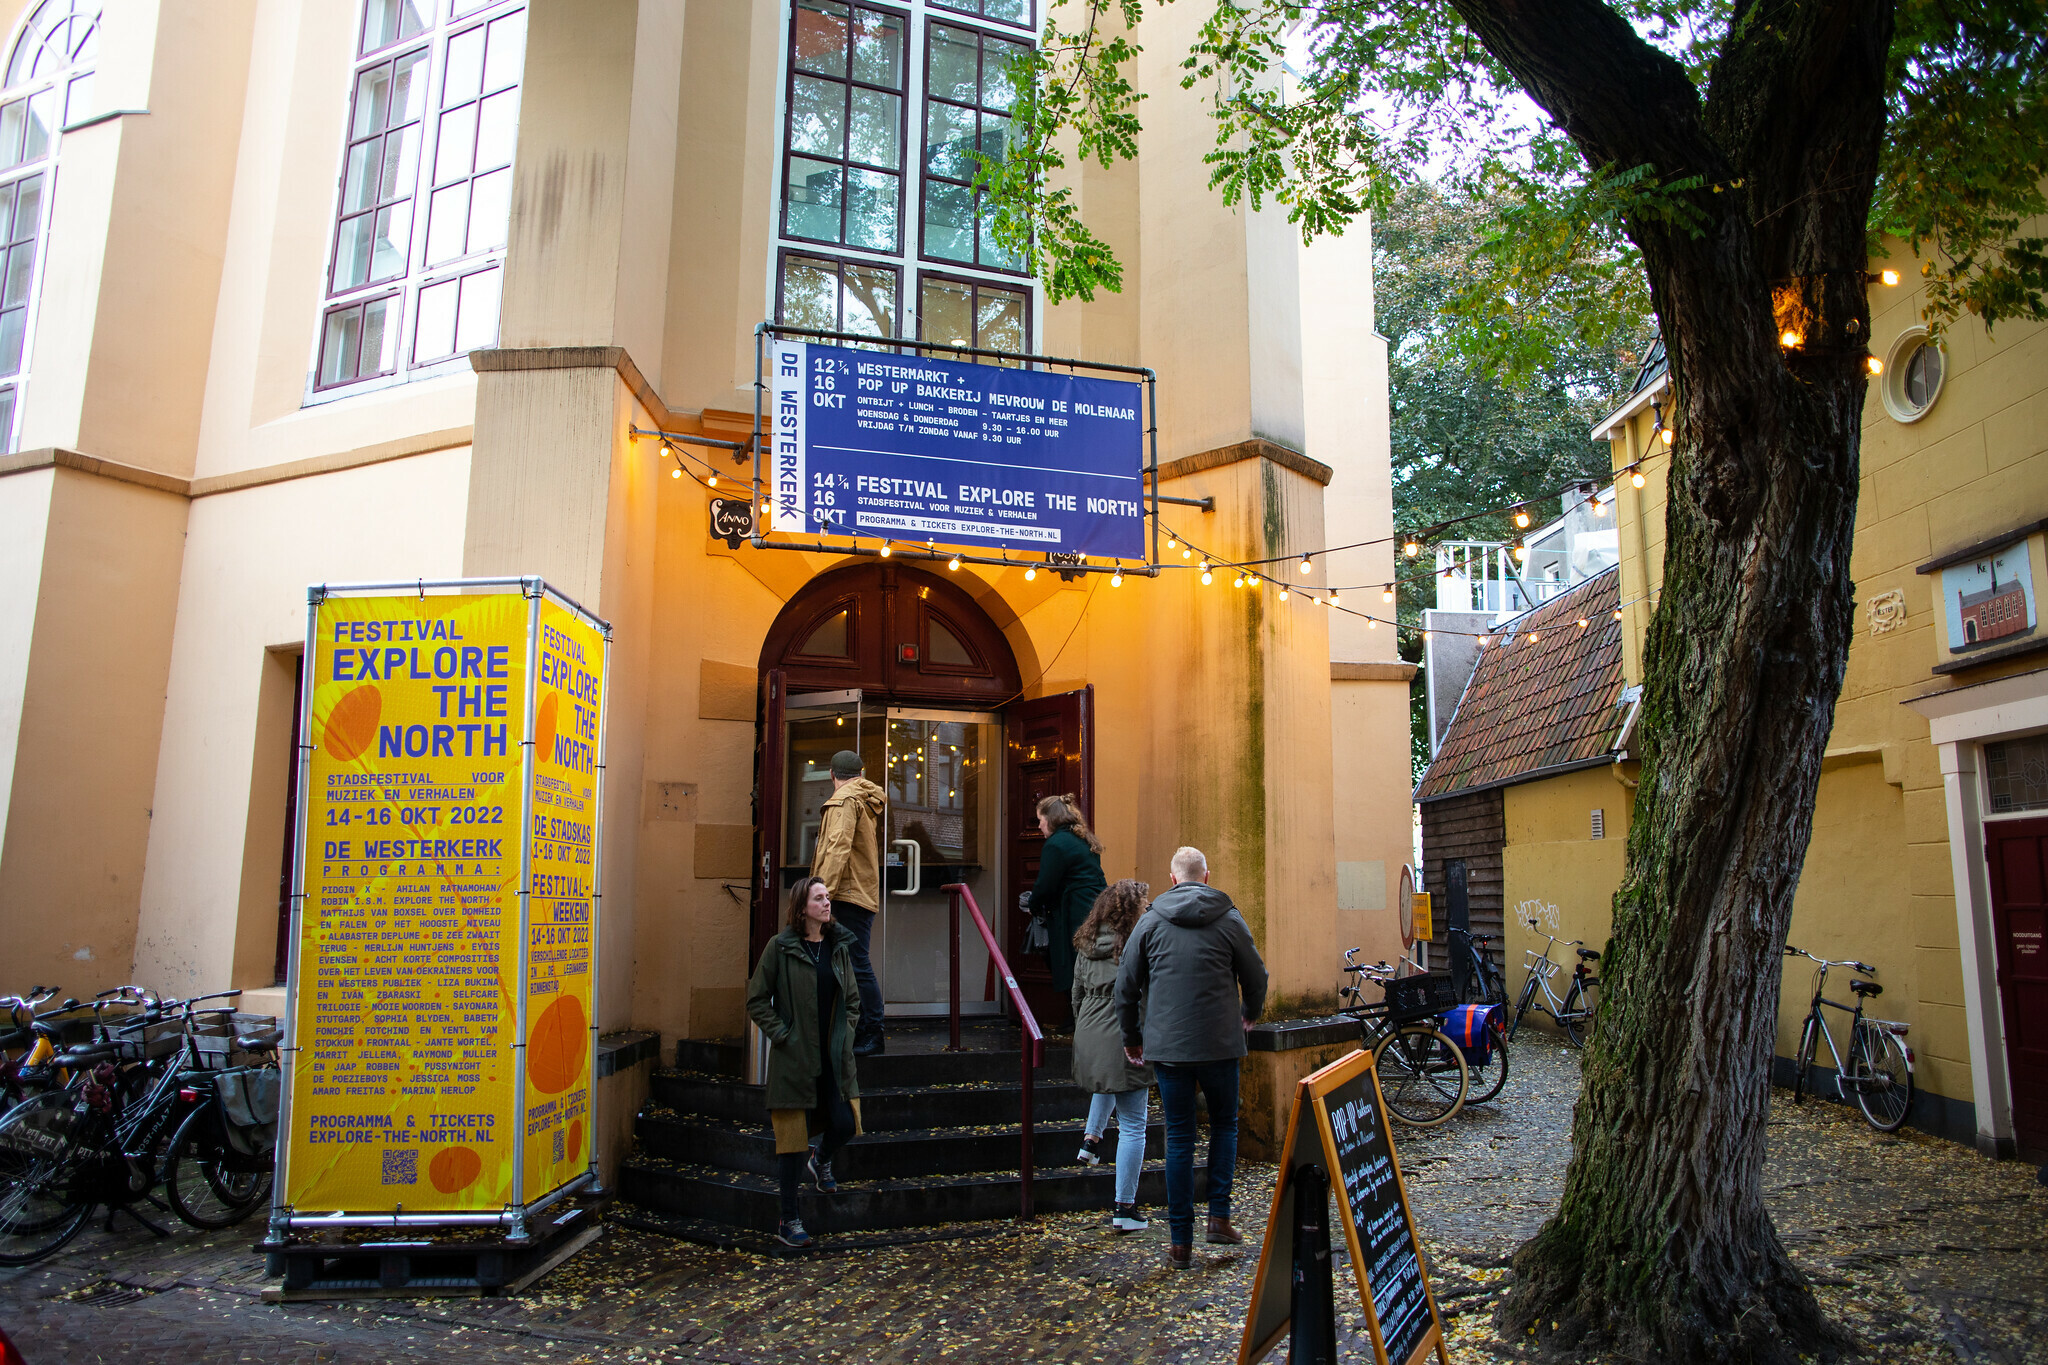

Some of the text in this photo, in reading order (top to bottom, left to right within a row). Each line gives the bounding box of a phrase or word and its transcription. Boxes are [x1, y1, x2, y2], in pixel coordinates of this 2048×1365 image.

[814, 358, 834, 373] 12
[858, 363, 949, 384] WESTERMARKT
[814, 375, 835, 391] 16
[814, 393, 845, 409] OKT
[858, 377, 1135, 420] POP UP BAKKERIJ MEVROUW DE MOLENAAR
[858, 397, 1068, 427] ONTBIJT LUNCH BRODEN TAARTJES MEER
[857, 420, 1002, 442] VRIJDAG ZONDAG VANAF 9.30
[858, 409, 1040, 435] WOENSDAG DONDERDAG 9.30 16.00
[780, 352, 798, 519] DE WESTERKERK
[814, 473, 834, 488] 14
[814, 490, 834, 505] 16
[857, 476, 1138, 517] FESTIVAL EXPLORE THE NORTH
[813, 508, 845, 524] OKT
[858, 497, 1037, 520] STADSFESTIVAL VOOR MUZIEK VERHALEN
[860, 515, 1058, 539] PROGRAMMA TICKETS EXPLORE-THE-NORTH.NL
[334, 620, 463, 642] FESTIVAL
[544, 624, 586, 665] FESTIVAL
[333, 646, 508, 681] EXPLORE
[541, 650, 598, 706] EXPLORE
[432, 685, 508, 717] THE
[574, 704, 595, 741] THE
[379, 724, 507, 758] NORTH
[555, 734, 593, 775] NORTH
[328, 772, 504, 784] STADSFESTIVAL VOOR
[327, 788, 475, 801] MUZIEK VERHALEN
[327, 807, 502, 826] 14-16 OKT 2022
[534, 815, 591, 844] DE STADSKAS
[325, 839, 502, 858] DE WESTERKERK
[534, 842, 590, 864] 1-16 OKT 2022
[532, 874, 589, 897] FESTIVAL-
[355, 897, 386, 905] I.S.M.
[321, 909, 365, 917] MATTHIJS
[553, 902, 589, 922] WEEKEND
[395, 920, 411, 928] HET
[329, 932, 378, 940] ALABASTER
[467, 931, 500, 939] ZWAAIT
[532, 927, 588, 945] 14-16 OKT 2022
[319, 956, 357, 964] EVENSEN
[339, 979, 378, 987] WESTERS
[465, 978, 499, 986] BUKINA
[453, 990, 498, 998] SELFCARE
[316, 1015, 365, 1024] STUTGARD,
[416, 1015, 454, 1023] BLYDEN,
[464, 1014, 498, 1022] BABETH
[316, 1027, 354, 1035] FONCHIE
[315, 1039, 354, 1047] STOKKUM
[425, 1038, 453, 1046] JANTE
[458, 1038, 496, 1047] WORTEL,
[314, 1051, 347, 1059] MARRIT
[358, 1051, 401, 1059] JELLEMA,
[334, 1063, 356, 1071] JAAP
[425, 1062, 481, 1070] PUSSYNIGHT
[458, 1074, 480, 1082] MOSS
[346, 1087, 385, 1095] FREITAS
[528, 1089, 586, 1121] PROGRAMMA TICKETS
[311, 1114, 495, 1128] PROGRAMMA TICKETS
[528, 1102, 586, 1136] EXPLORE-THE-NORTH.NL
[310, 1130, 494, 1143] EXPLORE-THE-NORTH.NL
